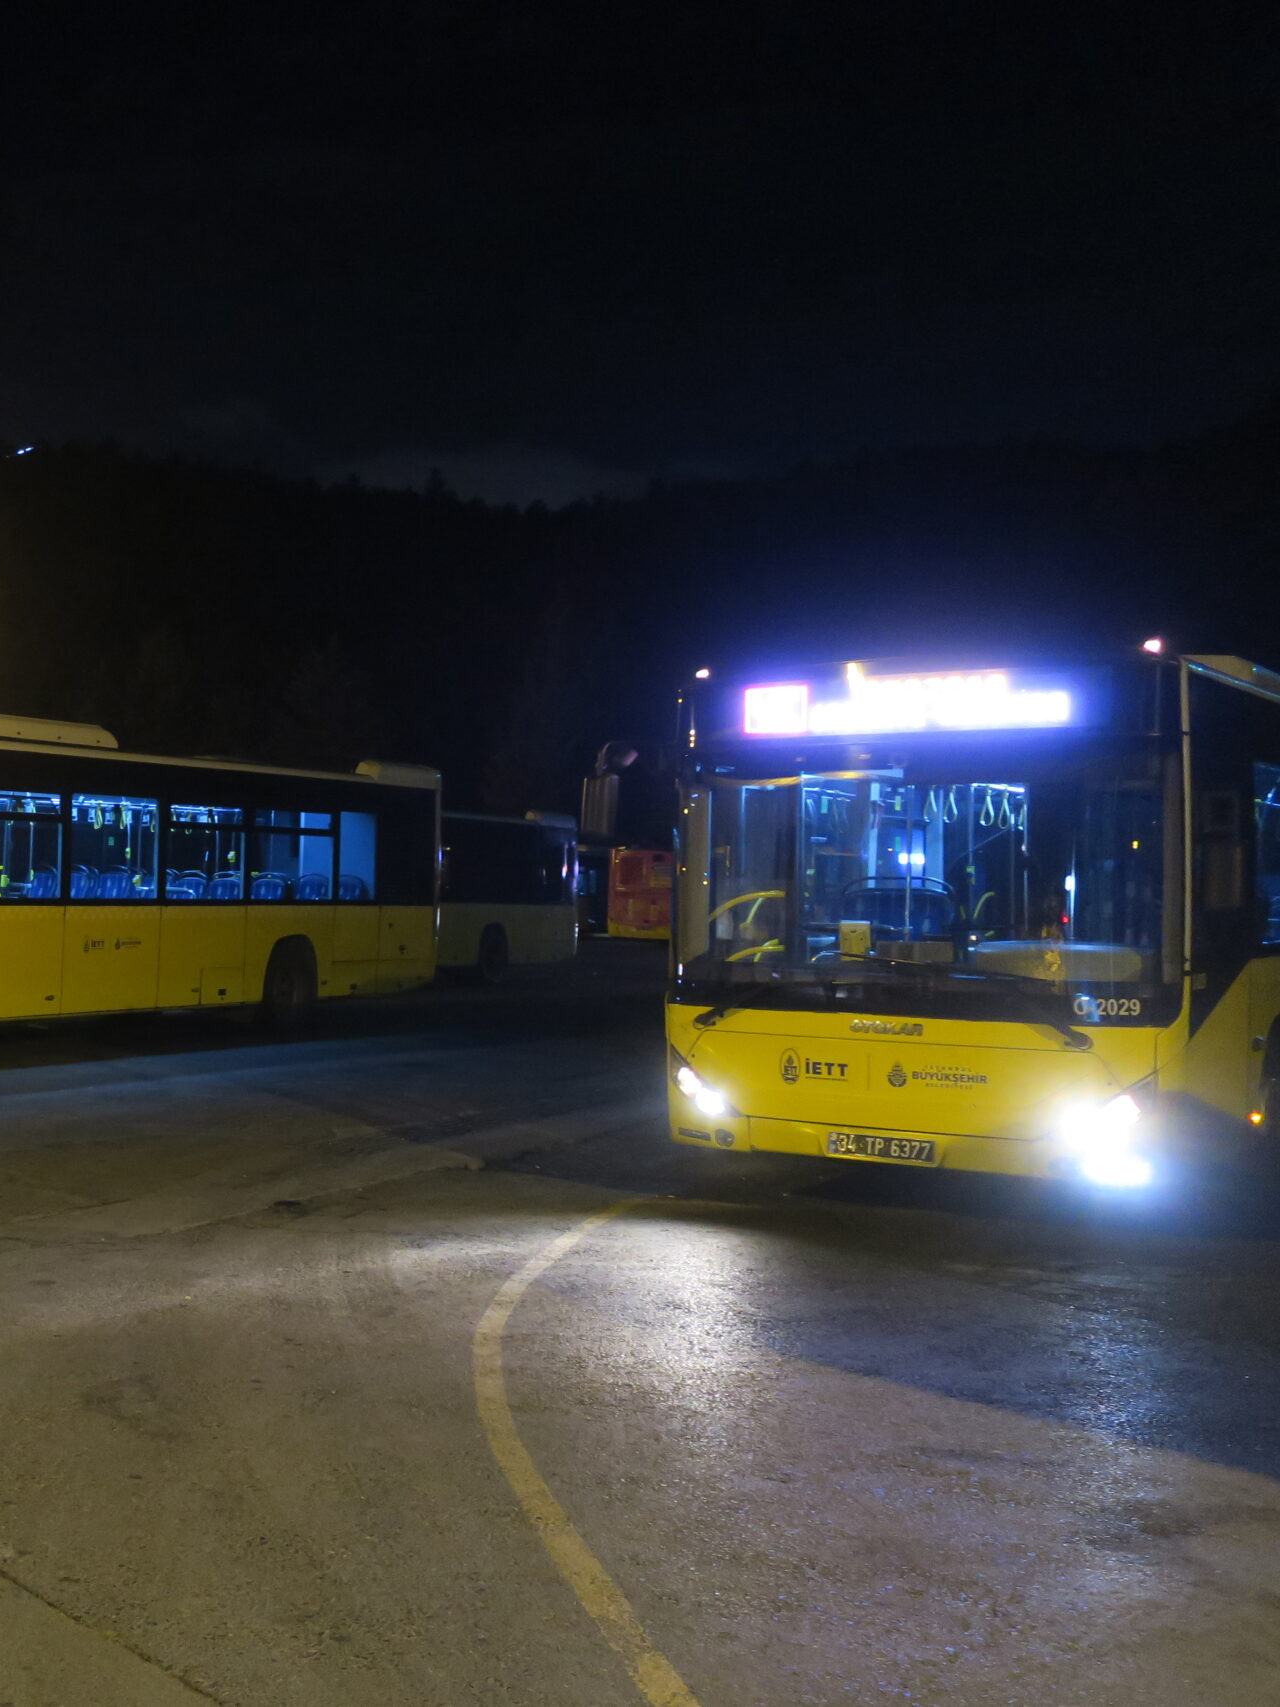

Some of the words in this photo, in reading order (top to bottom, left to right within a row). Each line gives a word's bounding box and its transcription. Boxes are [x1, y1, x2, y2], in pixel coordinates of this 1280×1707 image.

[1074, 998, 1141, 1016] O-2029
[849, 1019, 923, 1036] OTOKAR
[836, 1134, 857, 1153] 34
[866, 1137, 885, 1155] TP
[890, 1140, 932, 1160] 6377
